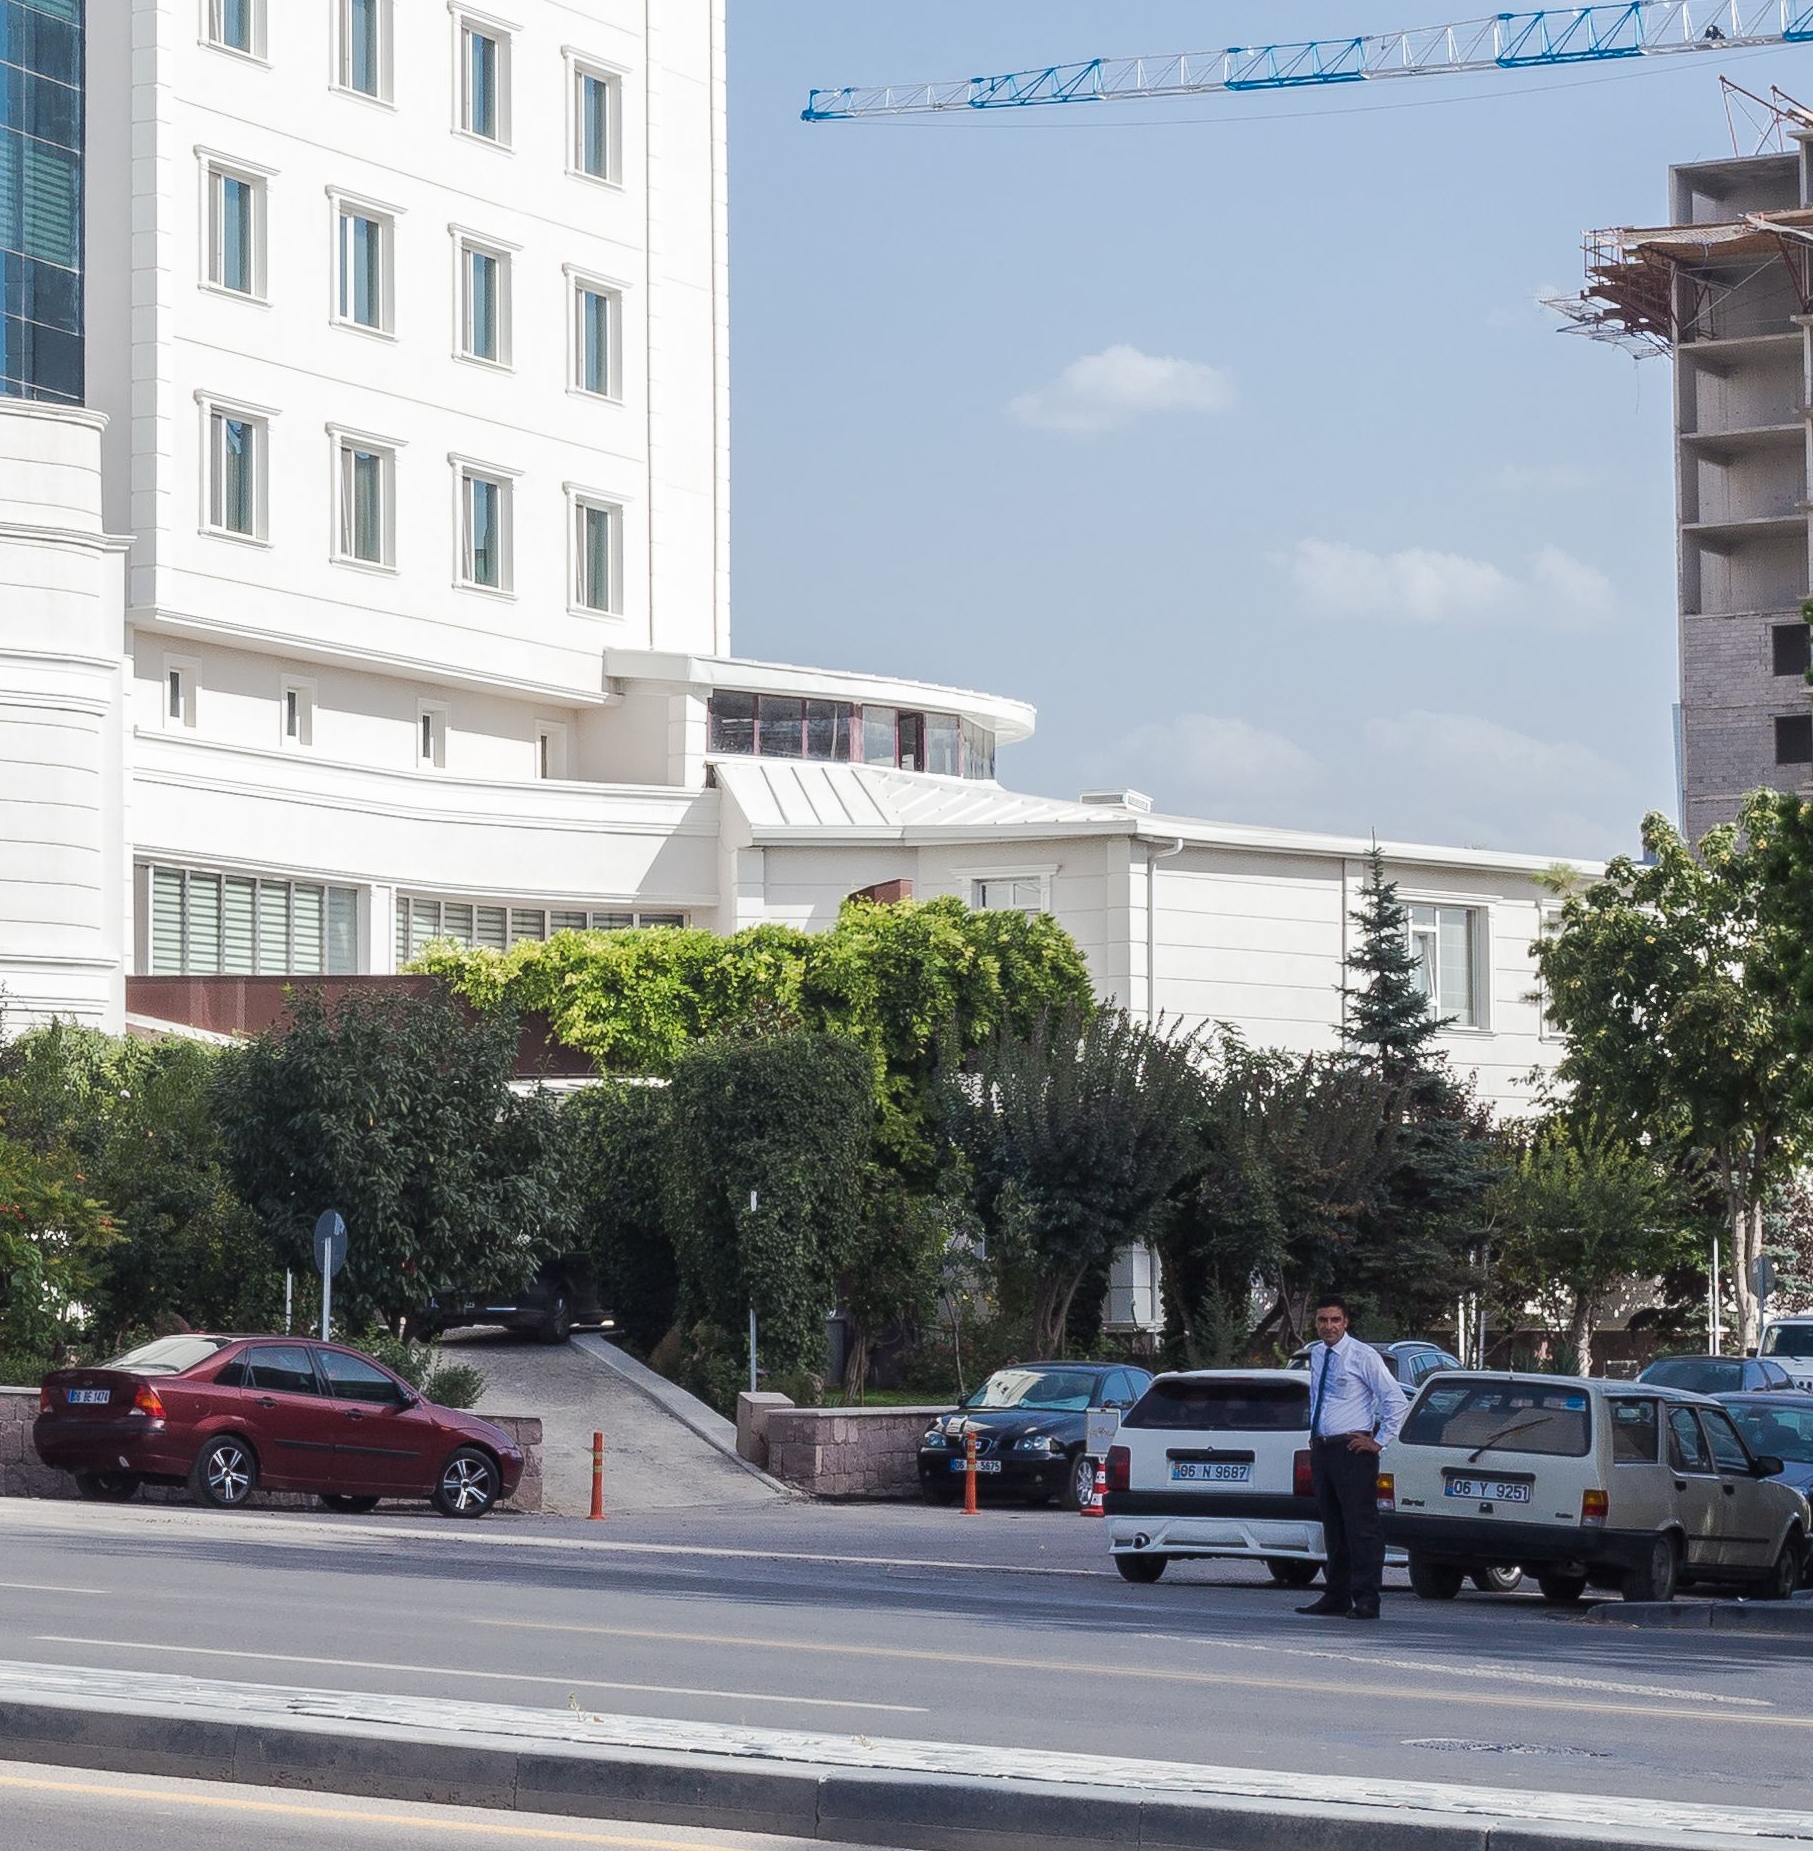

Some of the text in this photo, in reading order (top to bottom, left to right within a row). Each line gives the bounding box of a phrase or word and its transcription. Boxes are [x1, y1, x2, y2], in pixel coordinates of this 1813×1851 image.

[1180, 1465, 1247, 1479] 06 N 9687
[1454, 1480, 1527, 1500] 06 Y 9251
